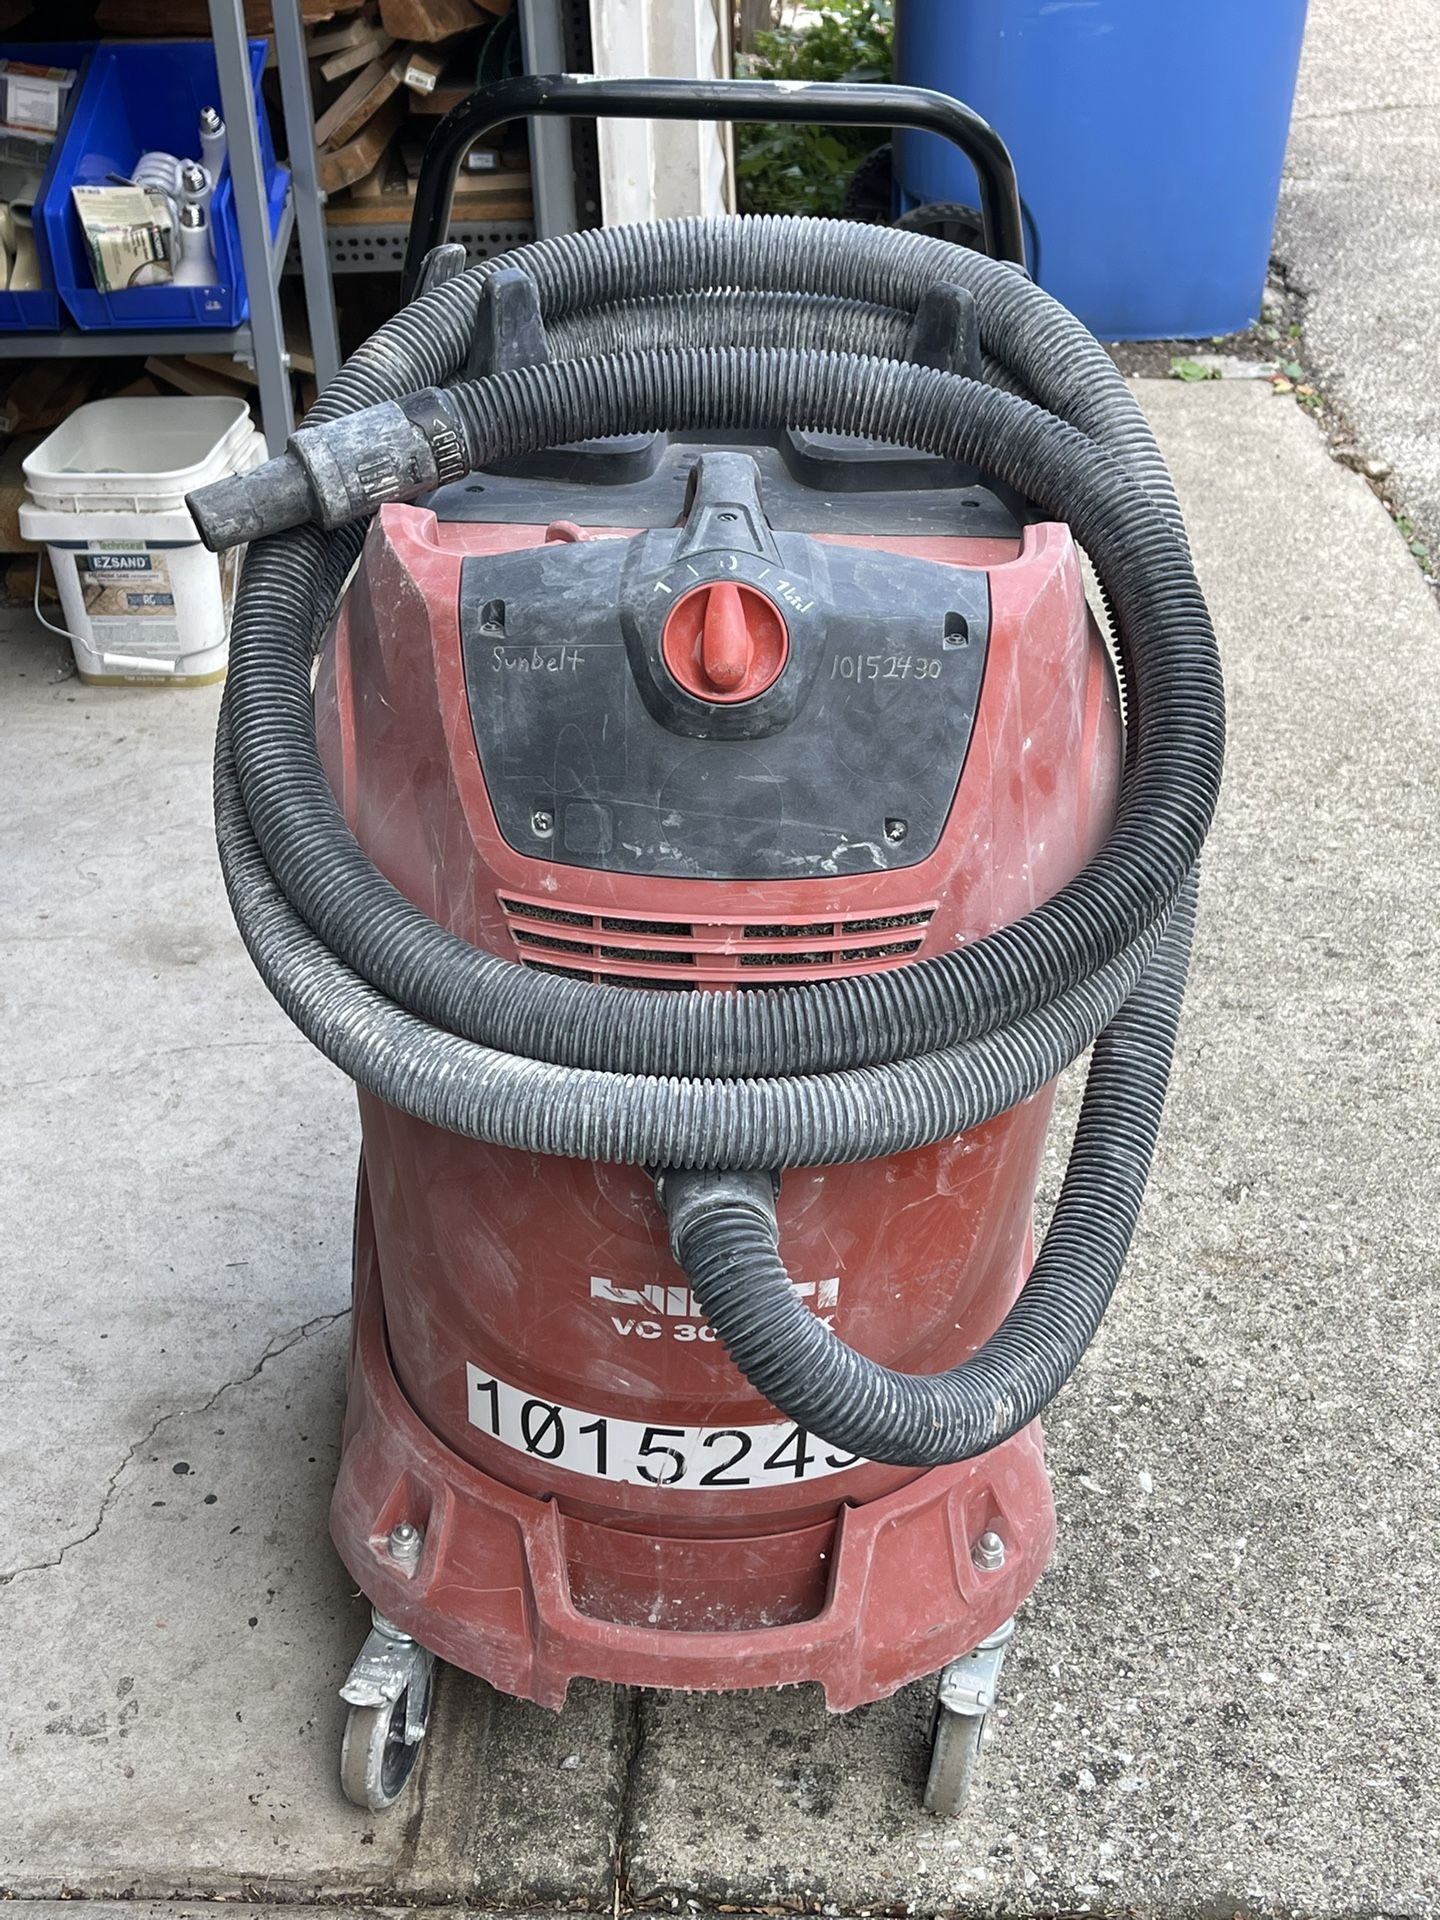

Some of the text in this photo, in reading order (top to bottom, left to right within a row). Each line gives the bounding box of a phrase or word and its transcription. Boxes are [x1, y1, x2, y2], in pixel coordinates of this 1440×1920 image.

[93, 556, 146, 569] EZSAND
[492, 646, 585, 672] Sunbelt
[830, 654, 943, 684] 10152430
[610, 1316, 663, 1340] VC
